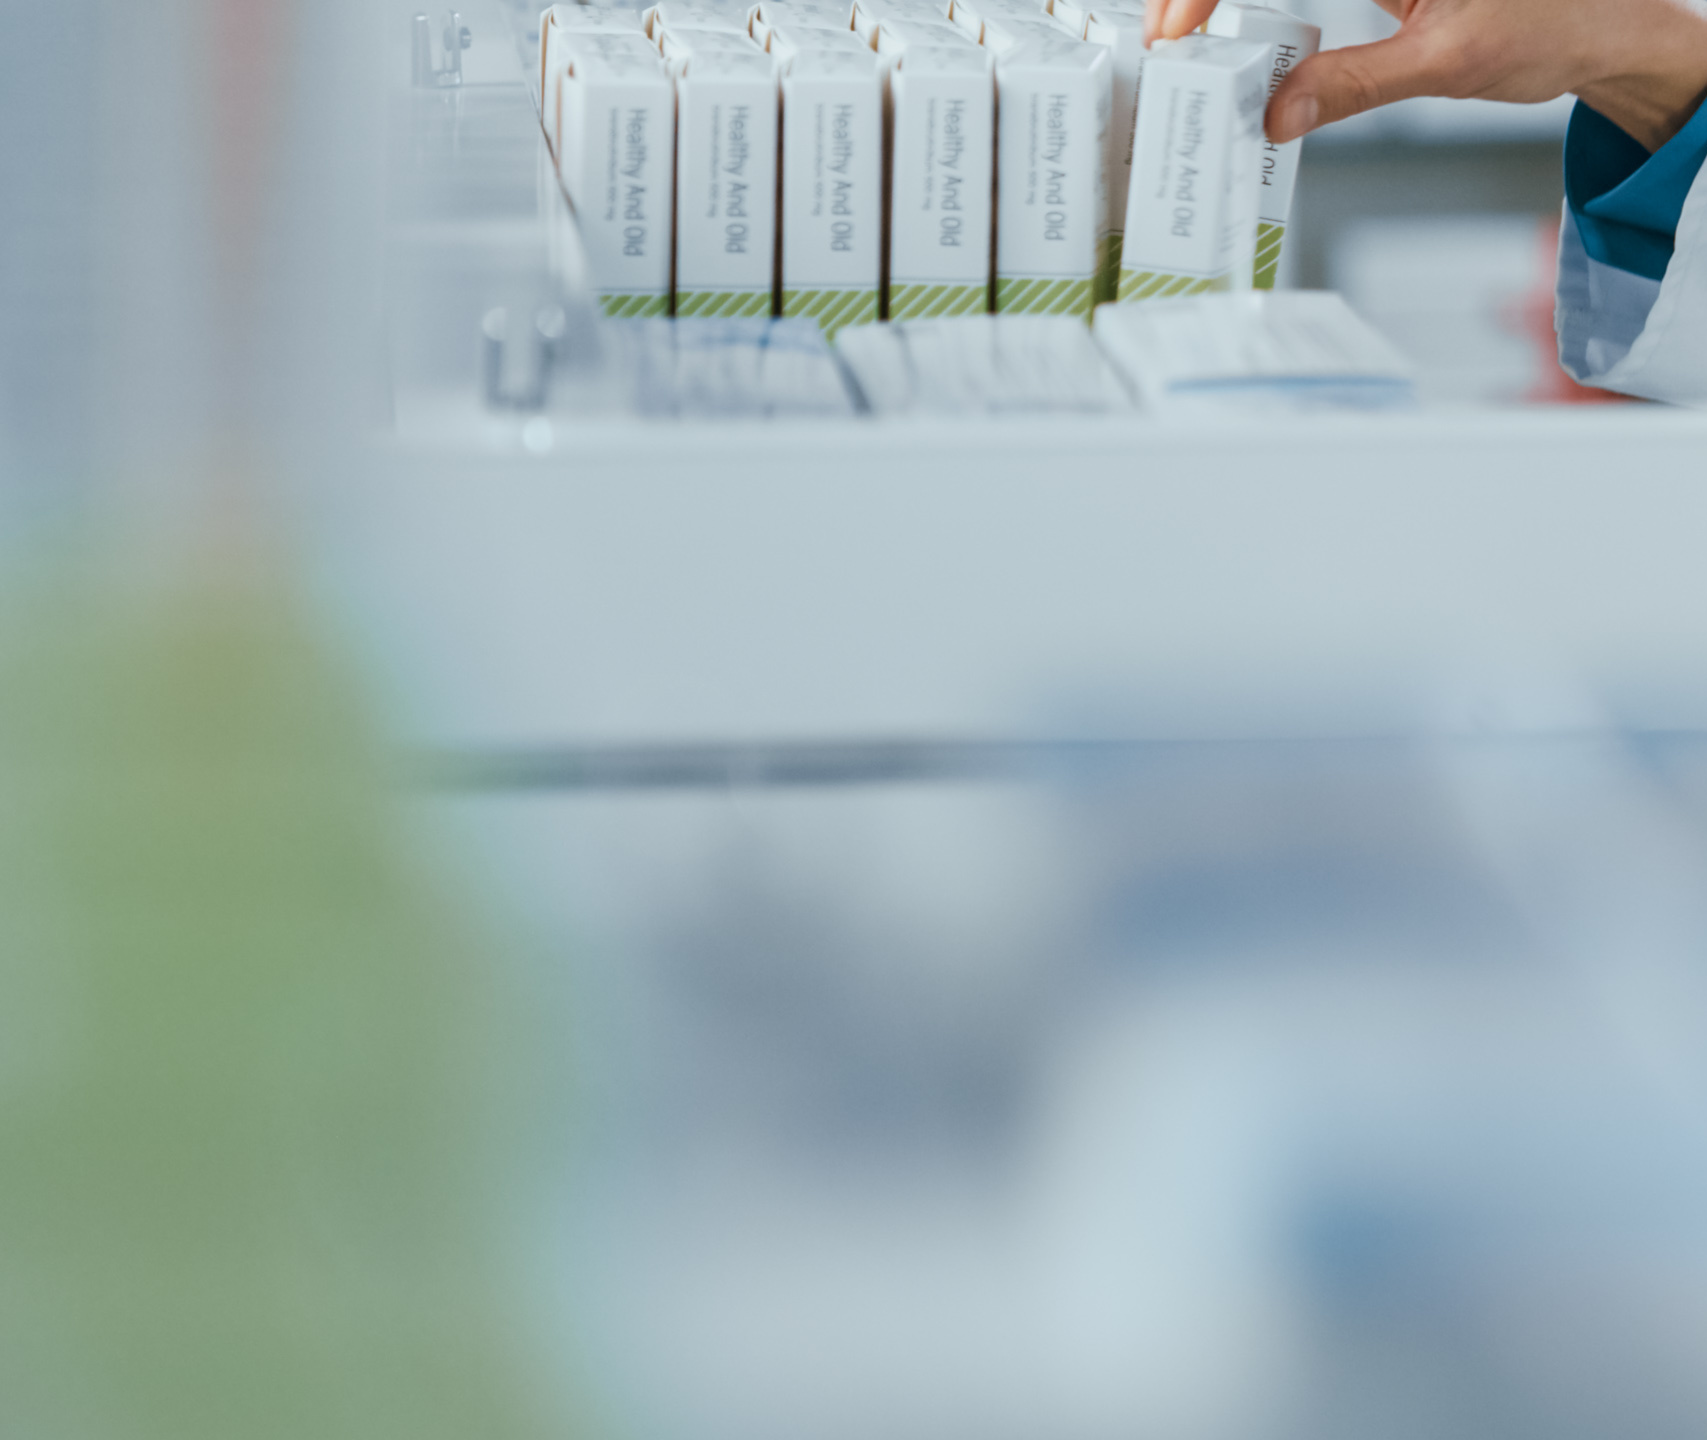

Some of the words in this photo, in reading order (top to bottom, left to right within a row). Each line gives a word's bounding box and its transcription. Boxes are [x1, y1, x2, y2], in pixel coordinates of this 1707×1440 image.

[722, 105, 749, 176] Healthy
[827, 105, 853, 174] Healthy
[938, 100, 964, 169] Healthy
[1042, 94, 1068, 164] Healthy
[1176, 91, 1208, 159] Healthy
[620, 109, 647, 179] Healthy
[726, 181, 748, 217] And
[831, 180, 852, 216] And
[940, 175, 963, 211] And
[1045, 170, 1066, 205] And
[1174, 166, 1199, 202] And
[624, 185, 646, 221] And
[725, 223, 747, 253] Old
[830, 221, 852, 252] Old
[939, 216, 962, 247] Old
[1044, 211, 1066, 241] Old
[1170, 208, 1194, 238] Old
[622, 226, 646, 257] Old
